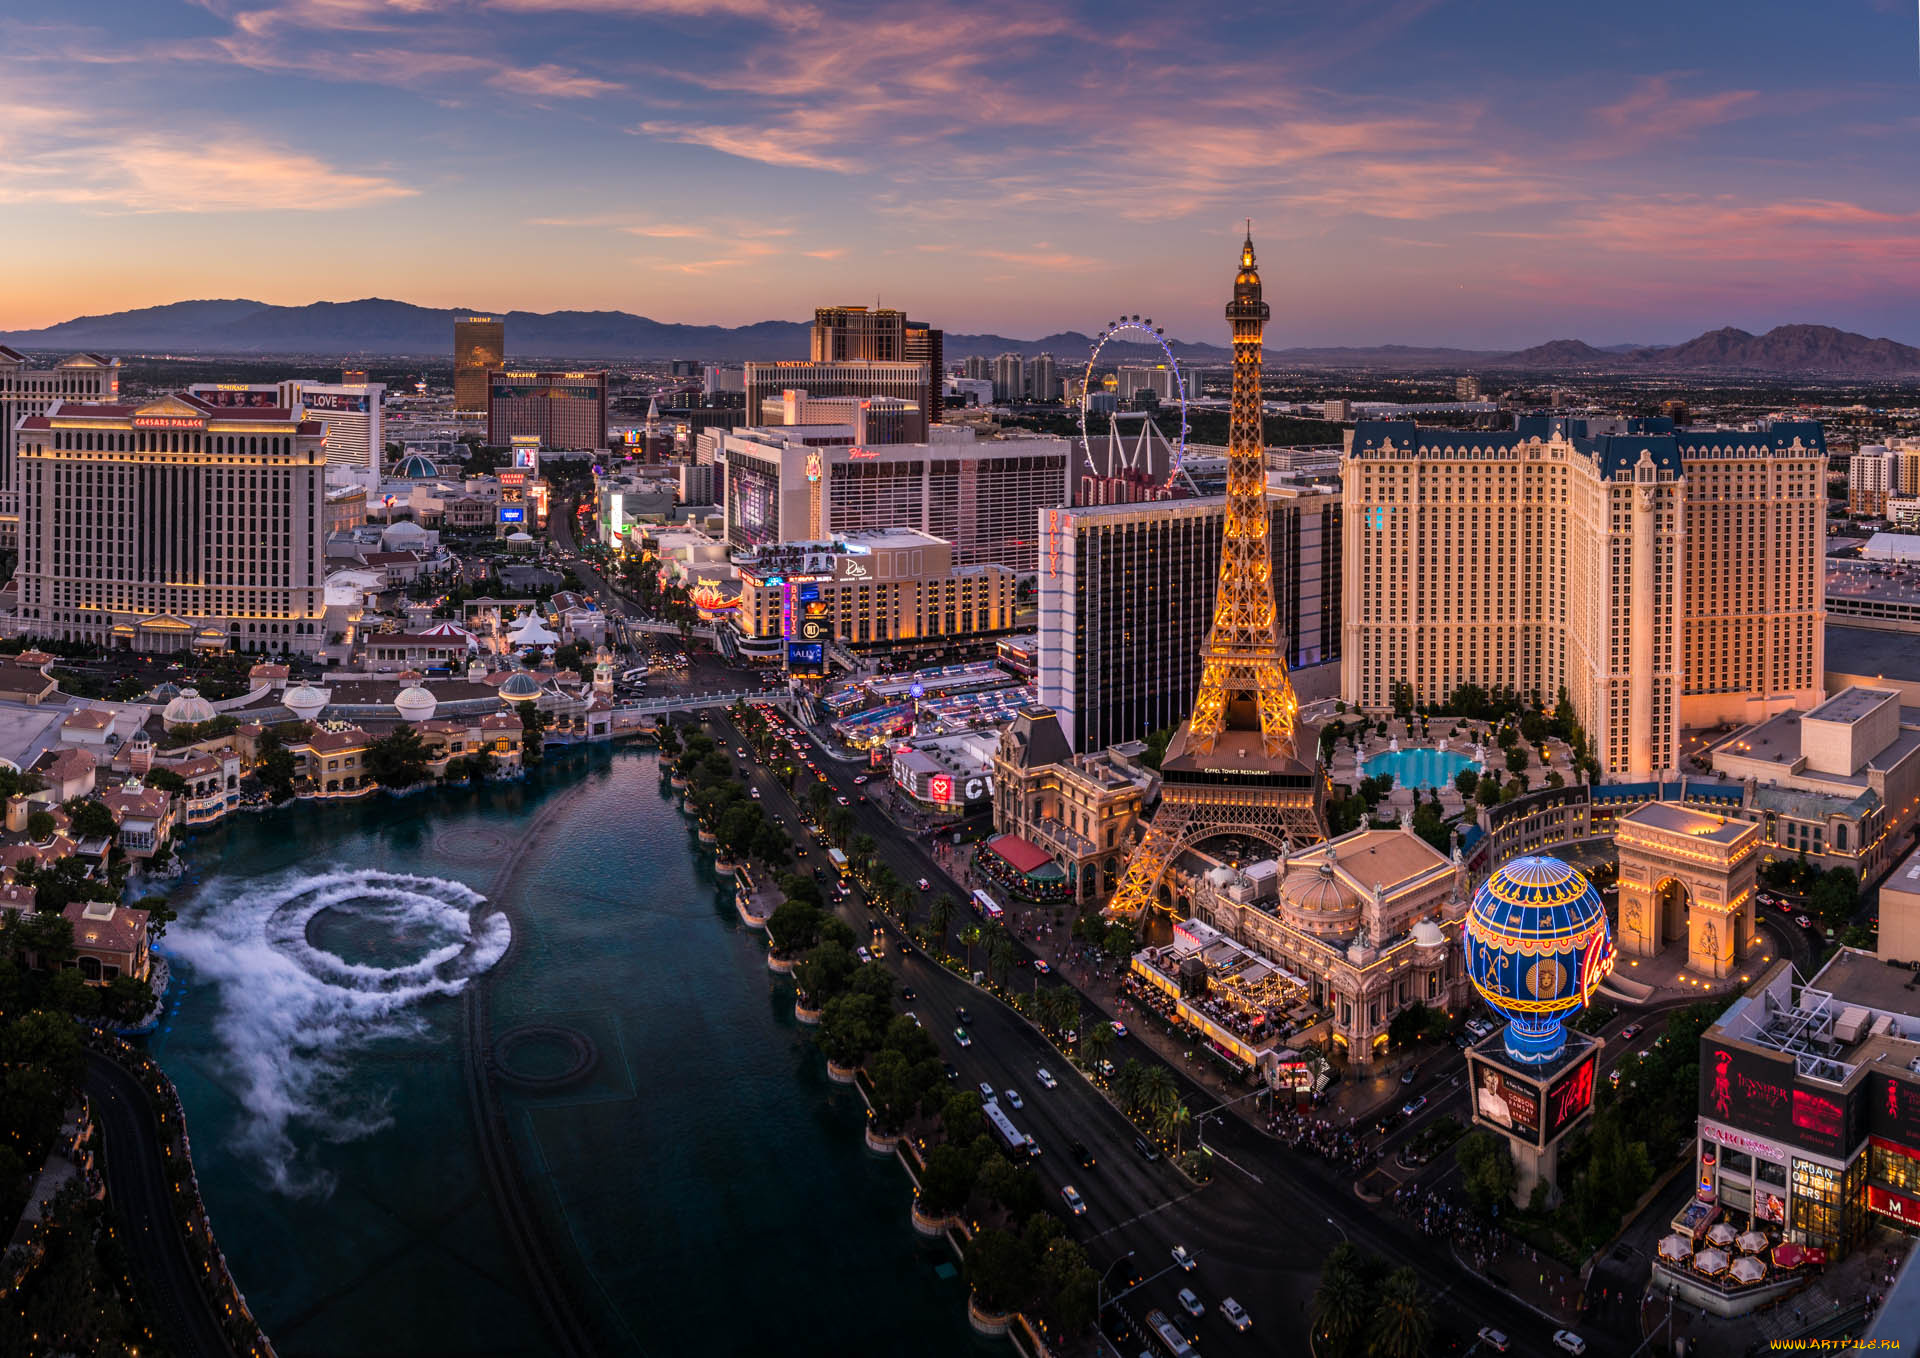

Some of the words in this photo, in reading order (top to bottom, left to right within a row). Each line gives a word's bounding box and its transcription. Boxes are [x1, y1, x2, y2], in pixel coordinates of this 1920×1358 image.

[313, 394, 338, 408] LOVE
[135, 418, 169, 427] CAESARS
[171, 418, 203, 427] PALACE
[892, 758, 917, 792] CVS
[1582, 932, 1618, 1008] Paris
[1508, 1093, 1534, 1109] GORDON
[1508, 1099, 1534, 1116] RAMSAY
[1792, 1158, 1834, 1180] URBAN
[1792, 1171, 1834, 1192] OUTFIT
[1792, 1182, 1820, 1200] TERS
[1889, 1198, 1901, 1214] M
